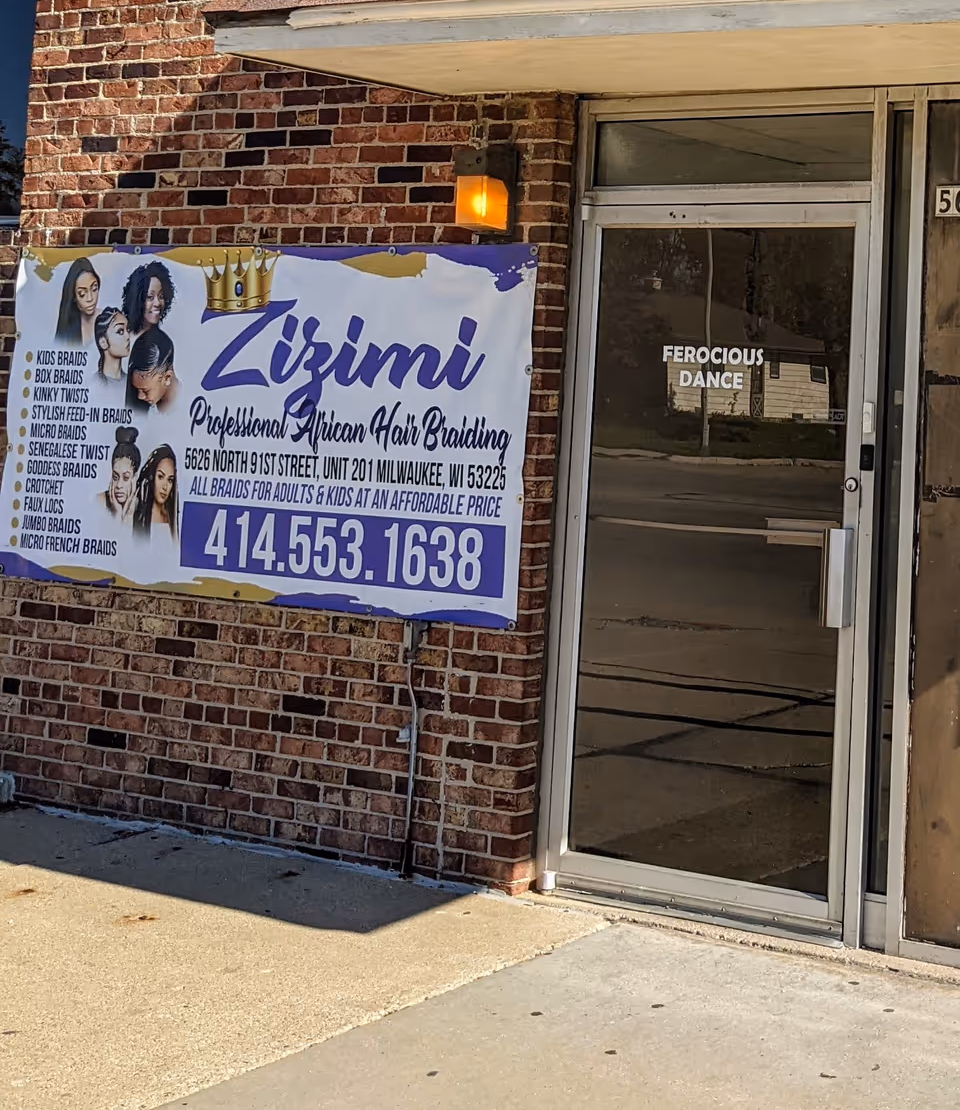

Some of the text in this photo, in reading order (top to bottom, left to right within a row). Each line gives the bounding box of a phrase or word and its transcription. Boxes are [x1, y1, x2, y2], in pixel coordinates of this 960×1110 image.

[36, 350, 88, 366] KIDS BRAIDS
[200, 298, 486, 419] Zizimi
[662, 345, 764, 366] FEROCIOUS
[34, 368, 84, 385] BOX BRAIDS
[679, 370, 744, 390] DANCE
[33, 387, 90, 404] KINKY TWISTS
[32, 405, 133, 425] STYLISH FEED-IN BRAIDS
[30, 423, 87, 441] MICRO BRAIDS
[189, 395, 513, 463] Professional African Hair Braiding
[28, 443, 111, 461] SENEGALESE TWIST
[27, 460, 98, 479] GODDESS BRAIDS
[184, 447, 507, 491] 5626 NORTH 91ST STREET, UNIT 201 MILWAUKEE, WI 53225
[25, 478, 65, 496] CROTCHET
[189, 476, 503, 518] ALL BRAIDS FOR ADULTS & KIDS AT AN AFFORDABLE PRICE
[23, 496, 64, 515] FAUX LOCS
[21, 515, 82, 535] JUMBO BRAIDS
[20, 533, 117, 557] MICRO FRENCH BRAIDS
[203, 508, 484, 591] 414.553.1638
